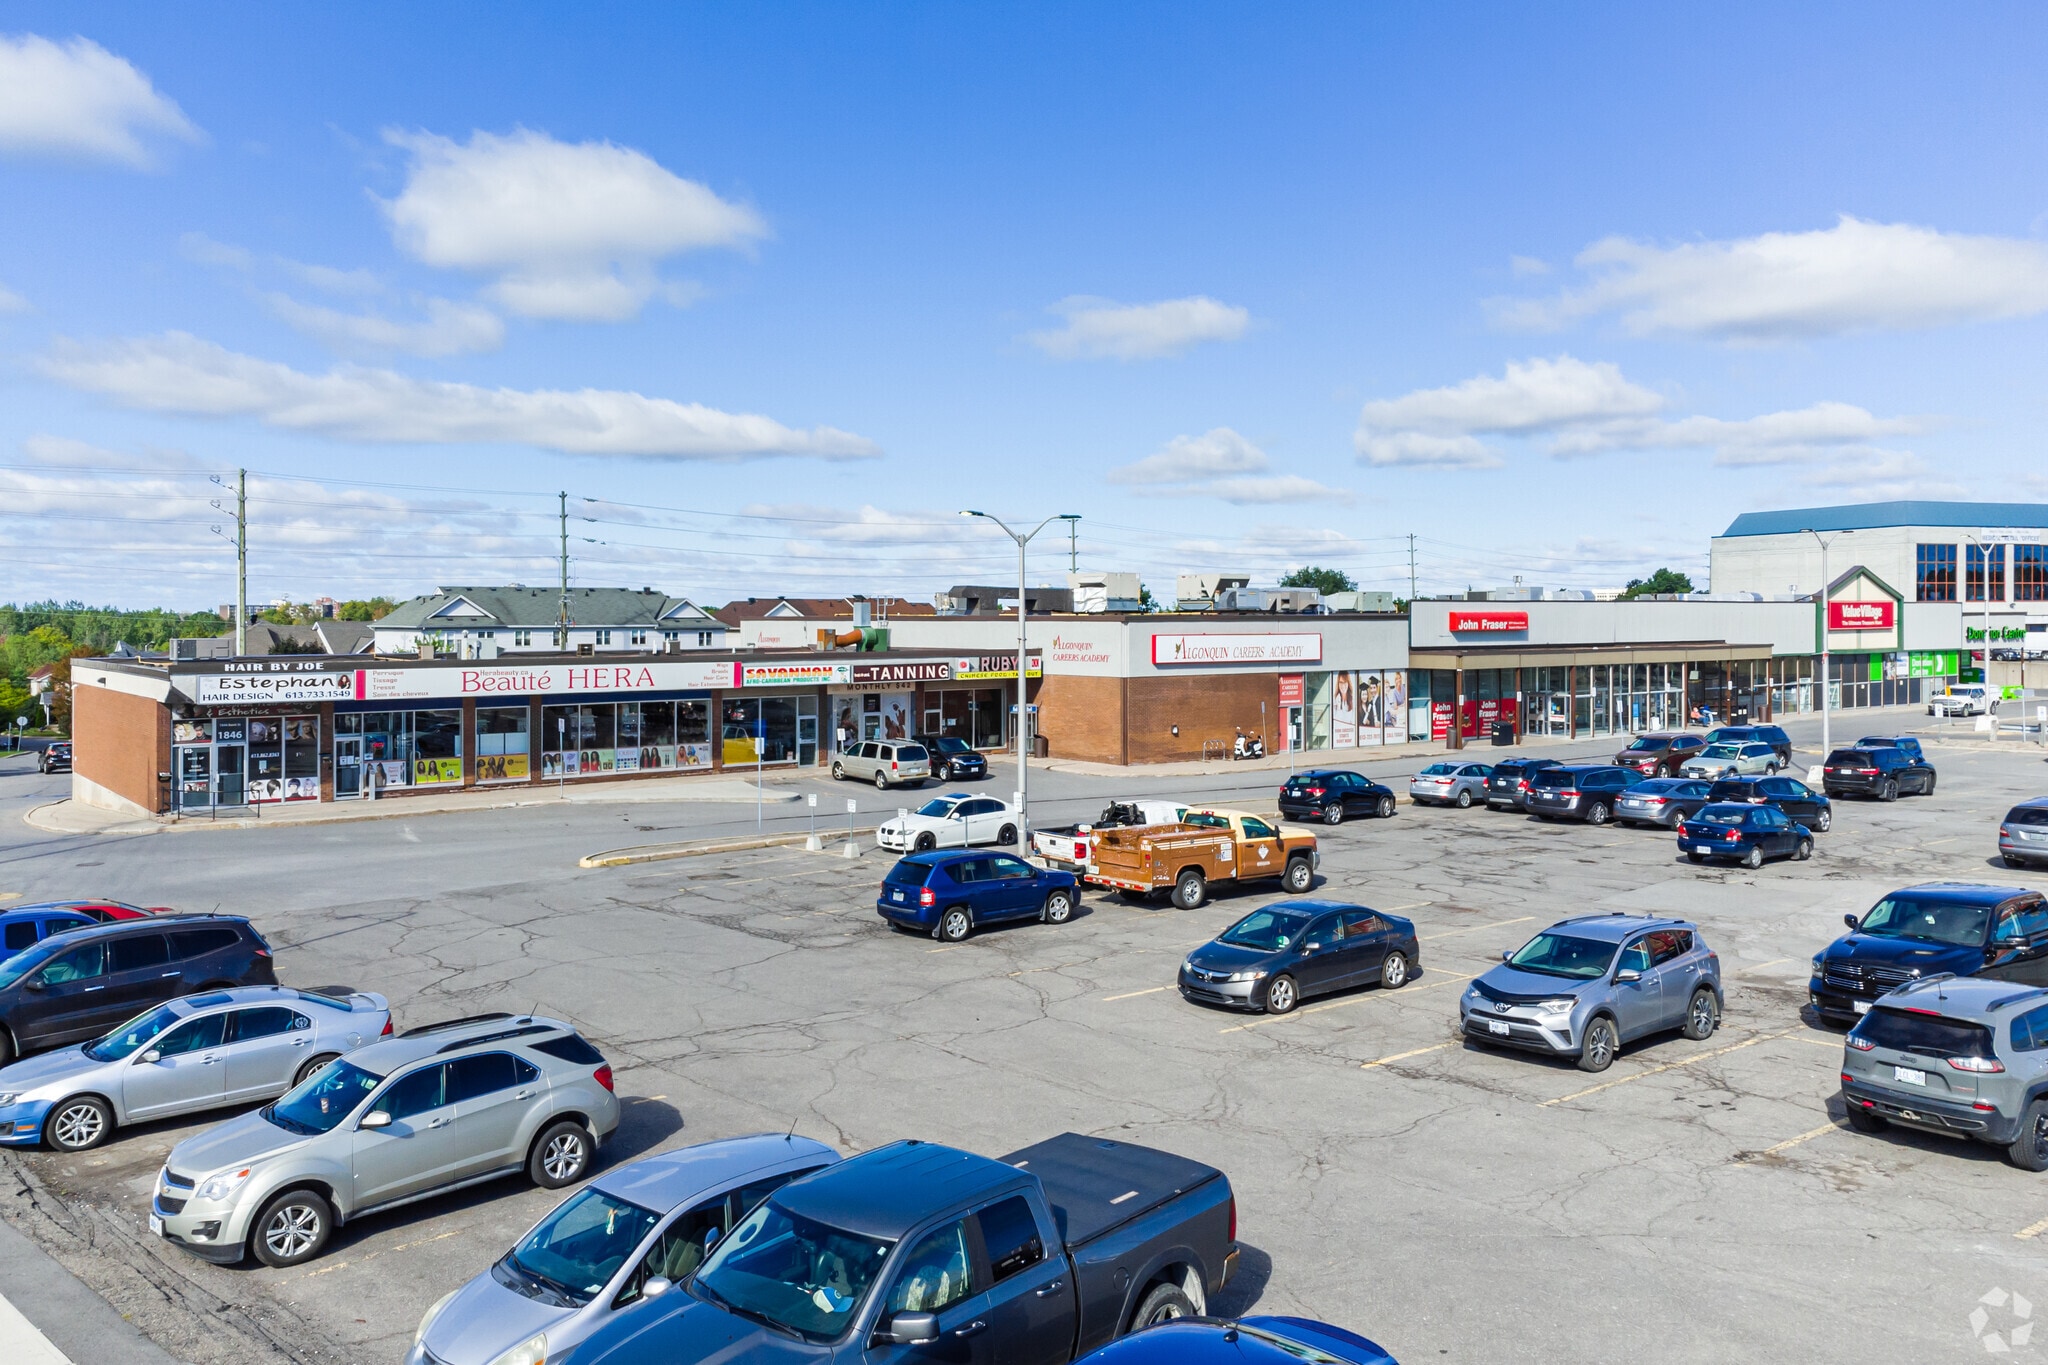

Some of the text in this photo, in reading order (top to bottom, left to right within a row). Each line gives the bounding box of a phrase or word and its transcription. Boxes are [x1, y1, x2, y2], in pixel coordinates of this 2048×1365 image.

[1458, 619, 1479, 630] John
[1482, 619, 1508, 630] Fraser
[1052, 635, 1094, 652] ALGONQUIN
[1174, 636, 1305, 660] ALGONQUIN CAREERS ACADEMY
[981, 656, 1019, 672] RUBY
[1052, 654, 1111, 663] CAREERS ACADEMY
[224, 662, 324, 672] HAIR BY JOE
[746, 666, 833, 679] SAVANNAH
[870, 664, 949, 680] TANNING
[219, 677, 334, 692] Estephan
[461, 667, 656, 692] Beauté HERA
[847, 682, 891, 691] MONTHLY
[202, 690, 351, 701] HAIR DESIGN 613.733.1549
[1435, 704, 1451, 712] John
[1432, 712, 1453, 720] Fraser
[1478, 710, 1498, 718] Fraser
[218, 730, 243, 740] 1846
